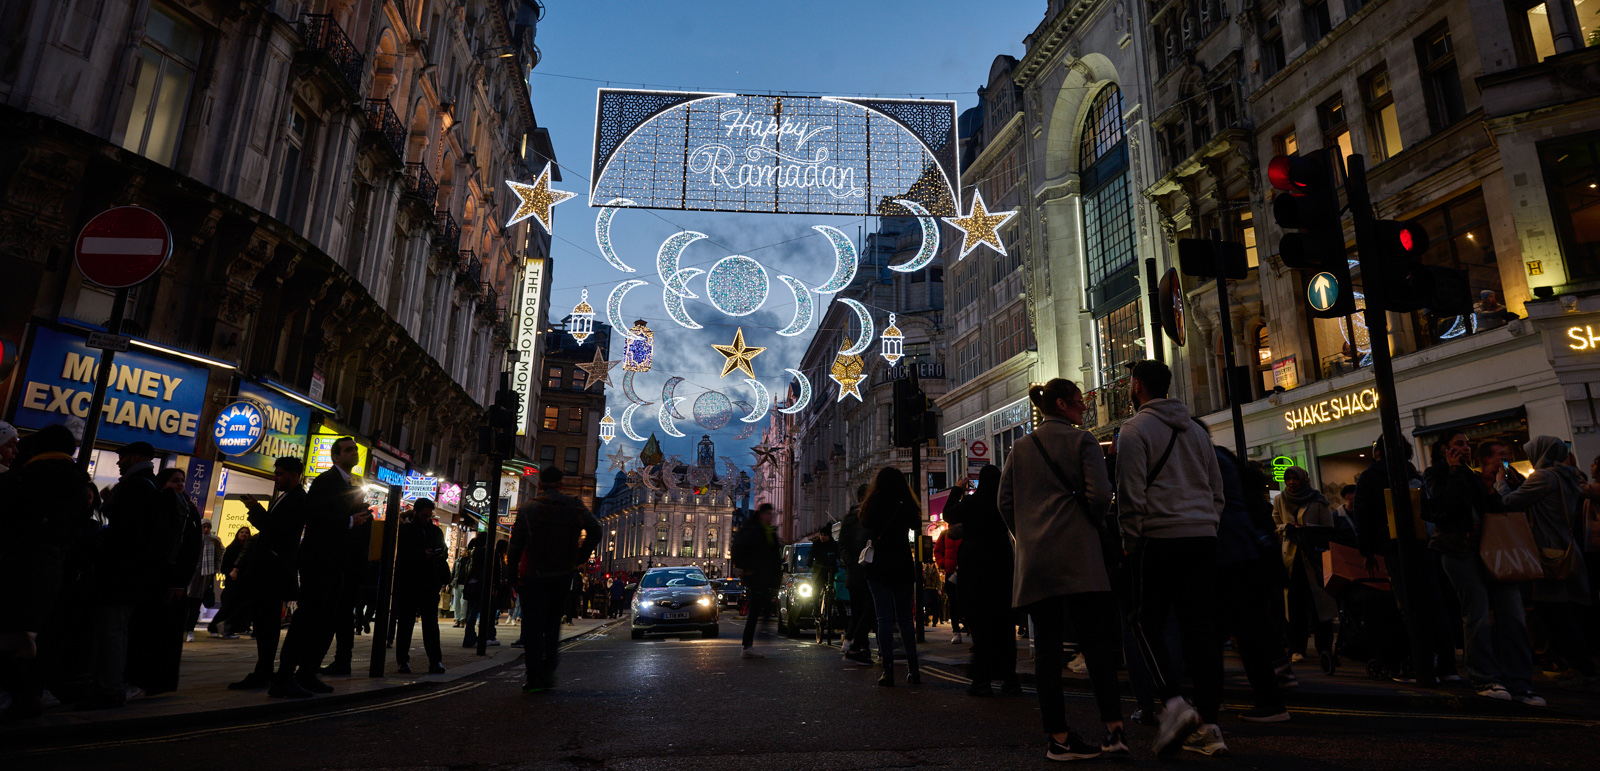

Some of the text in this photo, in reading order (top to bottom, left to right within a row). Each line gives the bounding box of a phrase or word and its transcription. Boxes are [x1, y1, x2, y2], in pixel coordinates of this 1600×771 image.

[720, 108, 832, 151] Happy
[689, 142, 866, 199] Ramadan
[1528, 261, 1543, 275] H
[516, 269, 539, 425] THE BOOK OF MORMON
[62, 352, 182, 401] MONEY
[883, 363, 943, 380] TROCAERO
[23, 381, 198, 438] EXCHANGE
[215, 405, 260, 437] CHANGE
[266, 405, 300, 436] ONEY
[1285, 388, 1379, 431] SHAKE SHACK
[219, 438, 253, 446] MONEY
[308, 437, 320, 474] OPEN
[465, 495, 478, 508] OPEN
